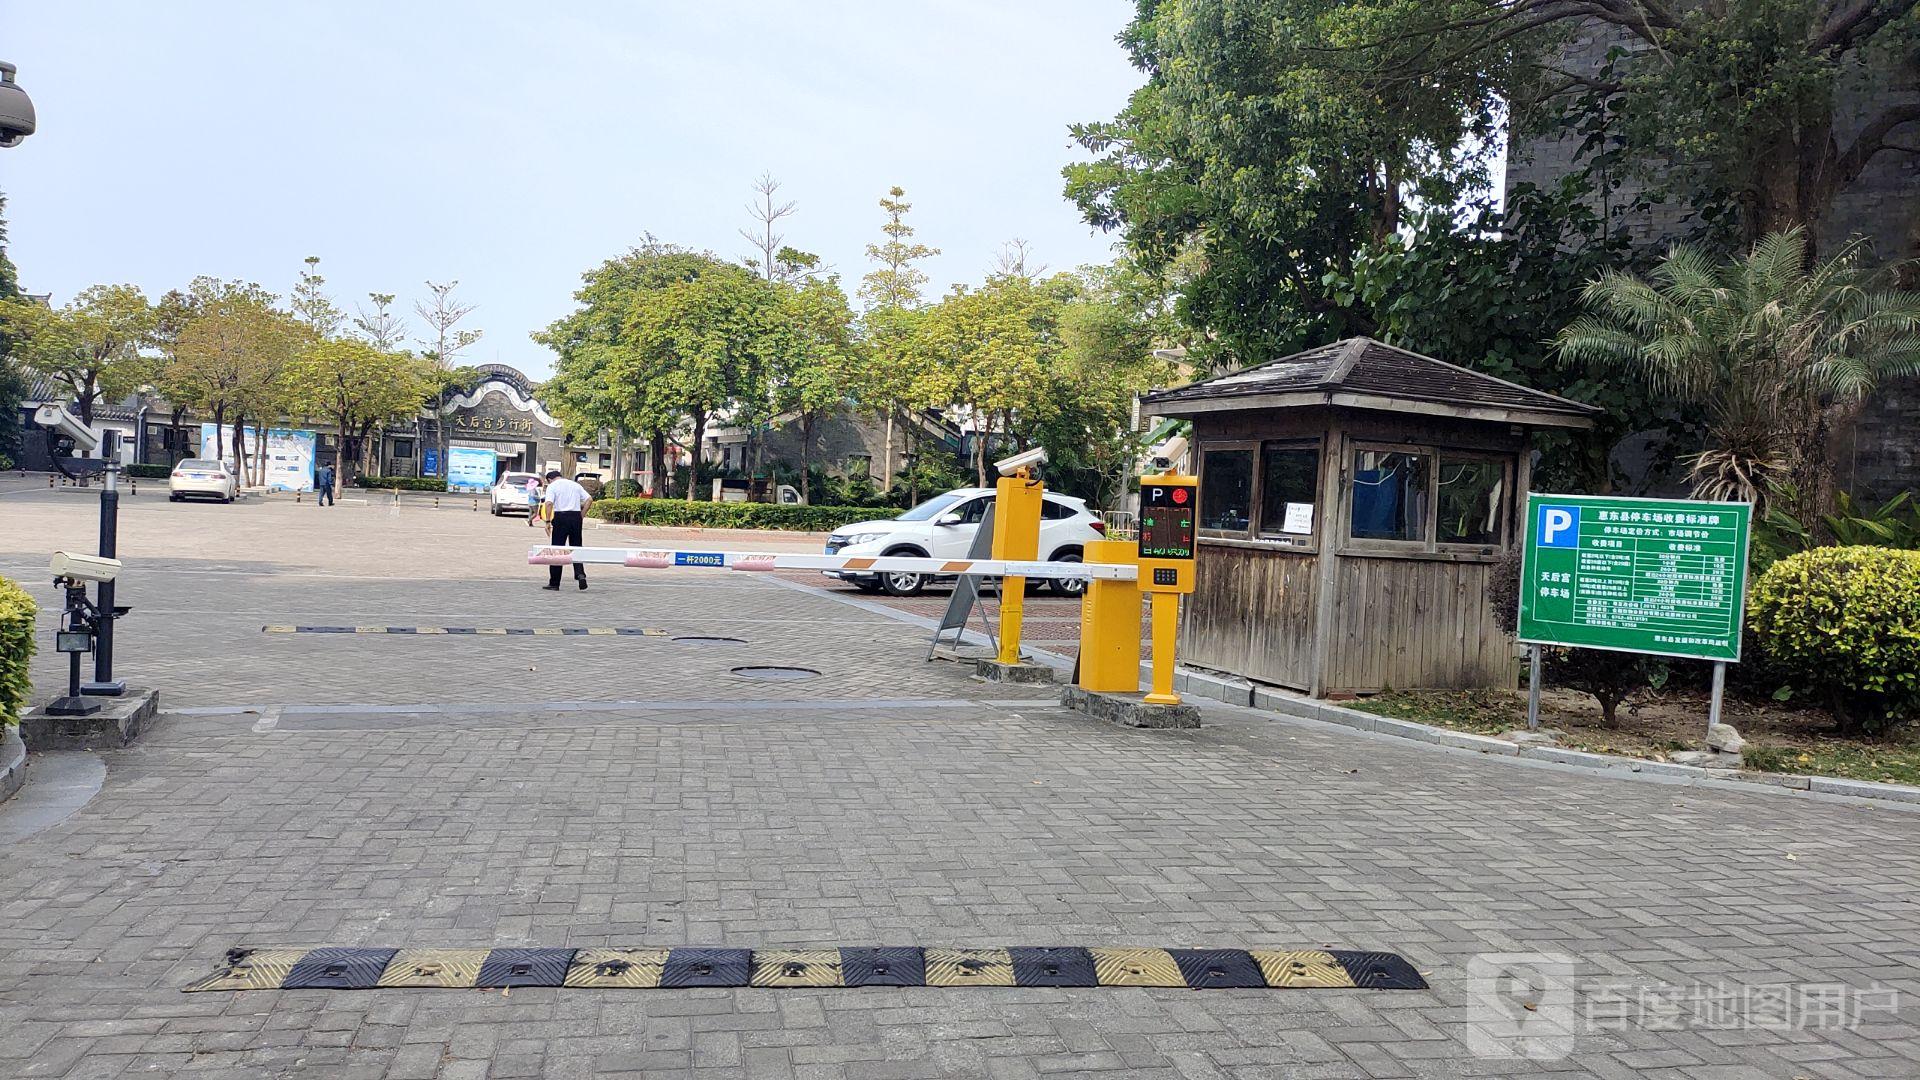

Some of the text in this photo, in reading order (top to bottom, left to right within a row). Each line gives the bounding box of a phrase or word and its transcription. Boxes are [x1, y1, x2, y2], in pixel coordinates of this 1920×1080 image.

[455, 415, 533, 431] 天后宫步行街
[1152, 488, 1163, 502] P
[1598, 511, 1720, 525] 惠东县停车场收费标准牌
[1544, 509, 1572, 544] P
[1592, 539, 1623, 548] 收费项目
[1668, 543, 1701, 552] 收费标准
[677, 554, 722, 565] 一杆2000元
[1541, 571, 1571, 583] 天后宫
[1540, 586, 1570, 599] 停车场
